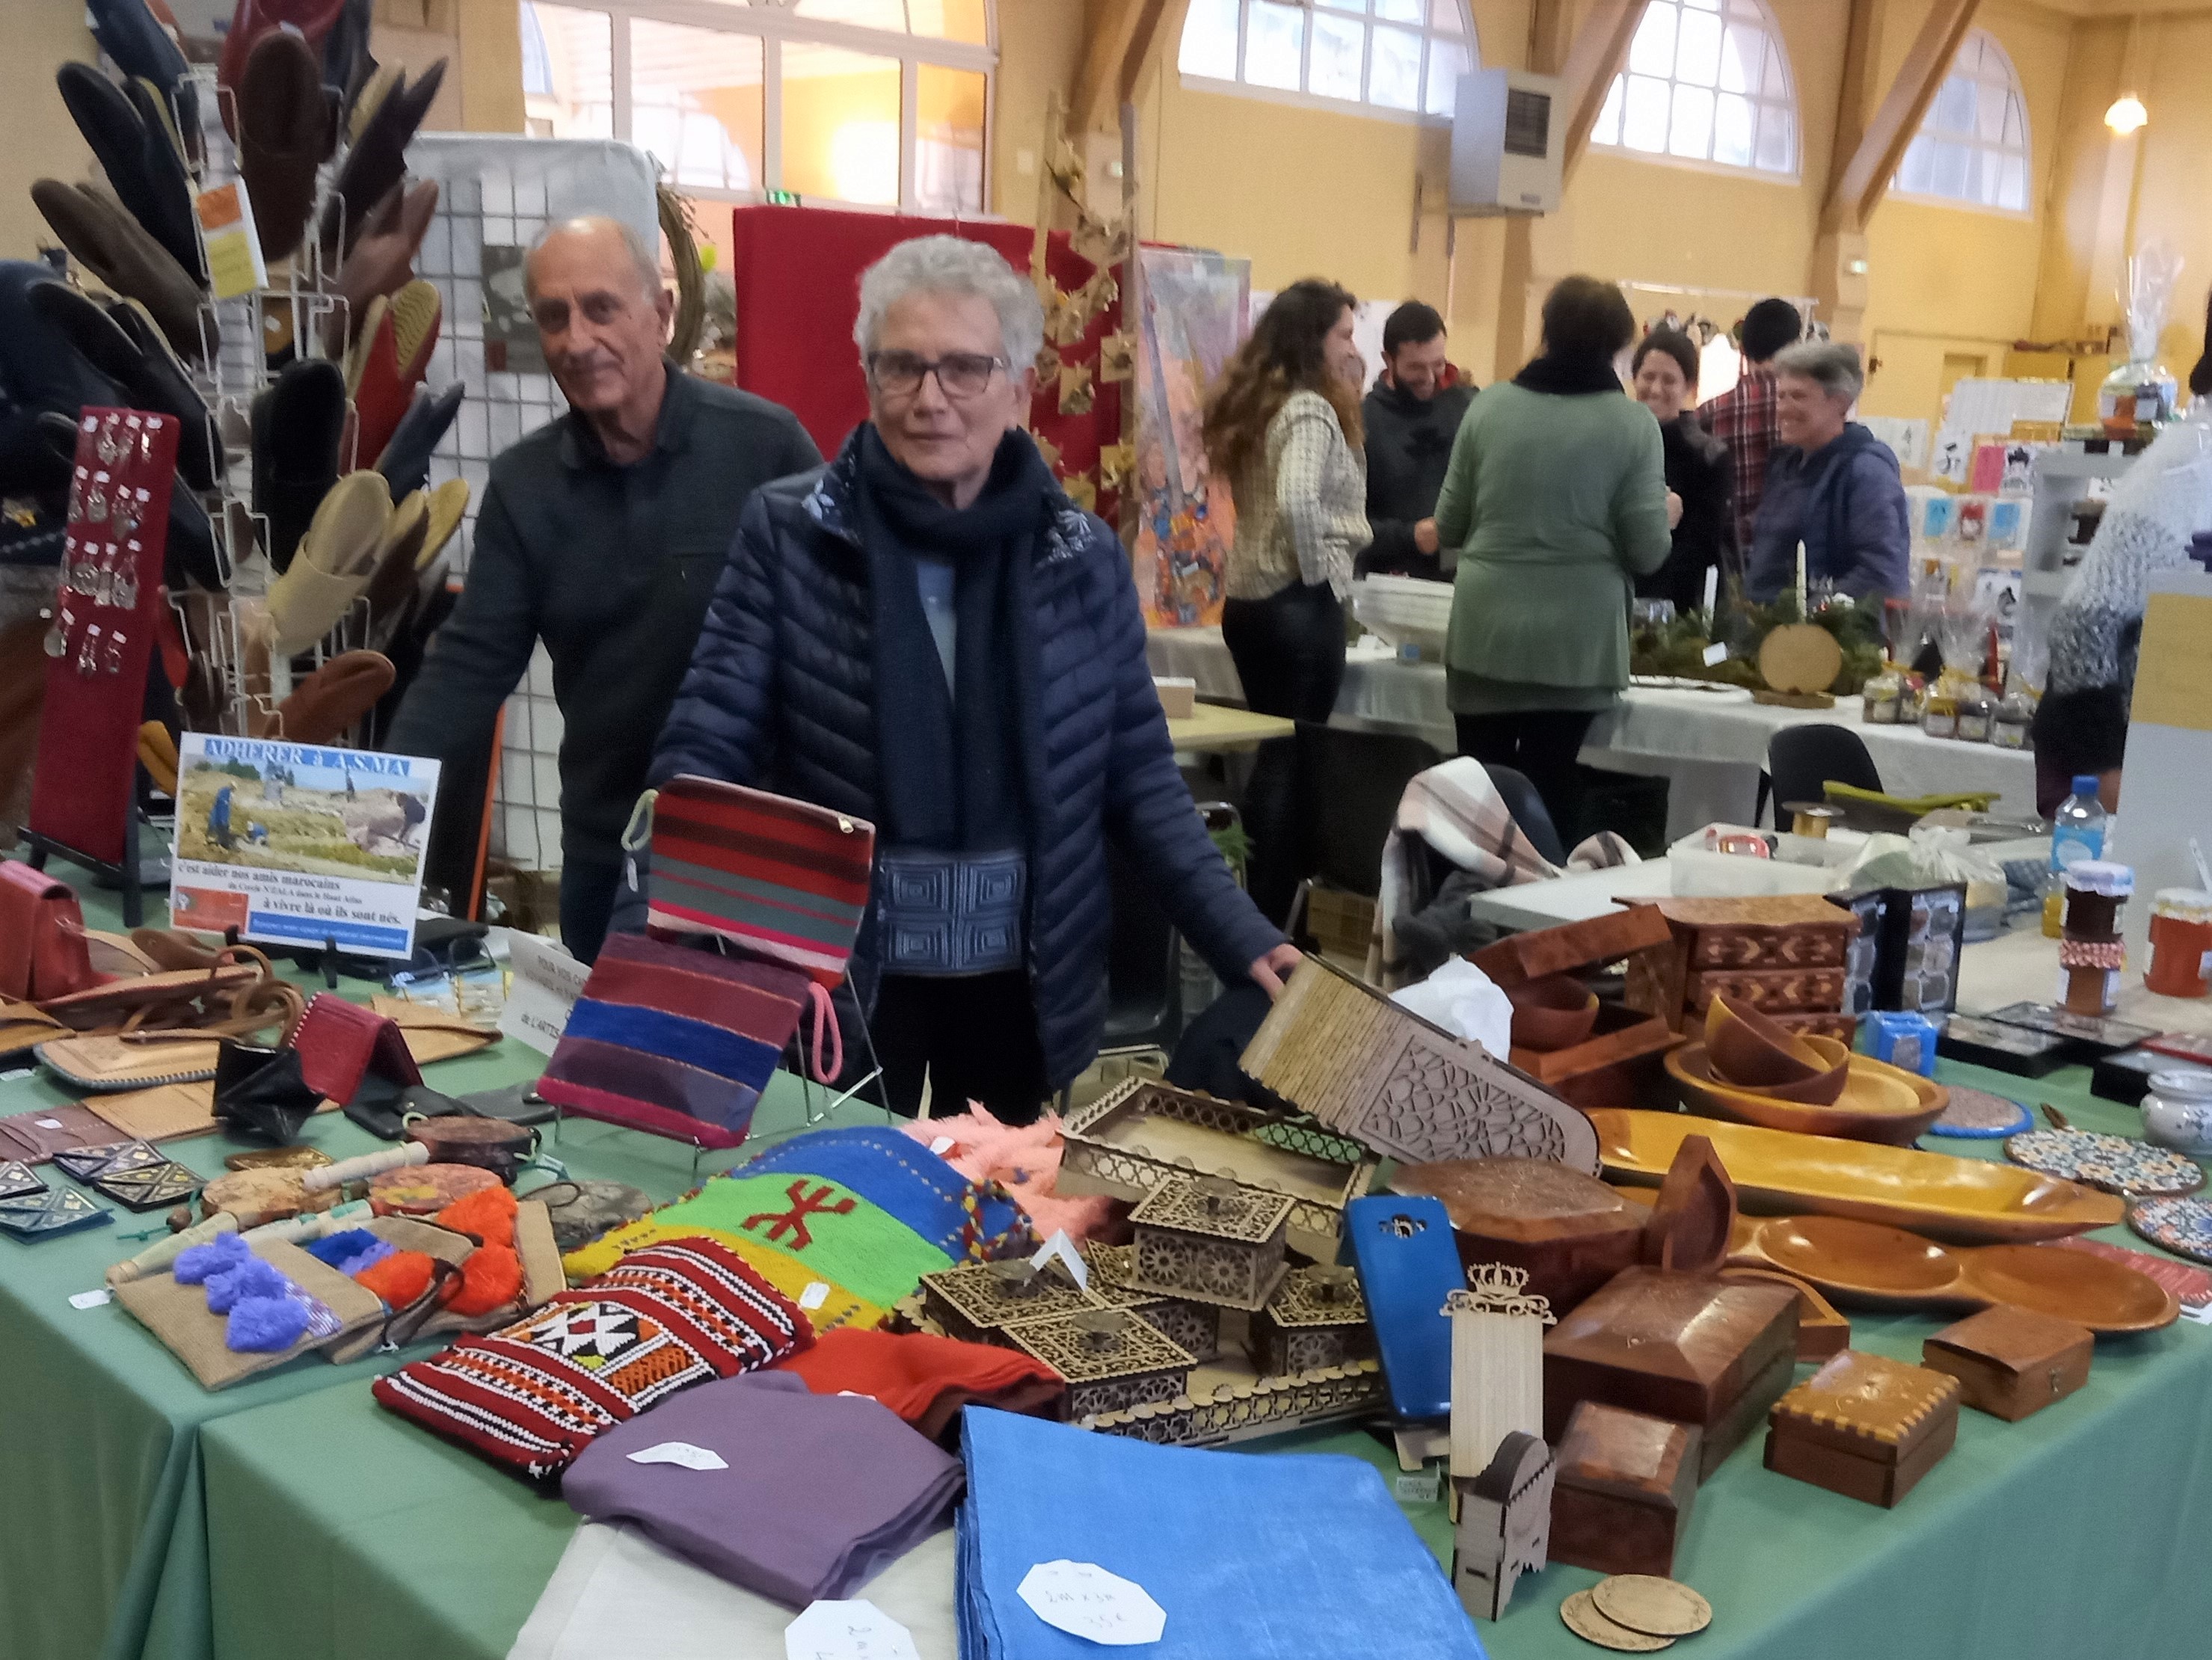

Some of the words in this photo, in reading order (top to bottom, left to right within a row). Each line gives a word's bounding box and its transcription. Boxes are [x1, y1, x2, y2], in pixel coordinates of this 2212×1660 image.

[209, 740, 302, 764] ADHERER
[202, 865, 229, 877] aider
[232, 870, 249, 879] nos
[253, 871, 279, 883] amis
[282, 876, 341, 889] marocains
[273, 899, 301, 912] vivre
[335, 905, 348, 917] ils
[351, 909, 376, 921] sont
